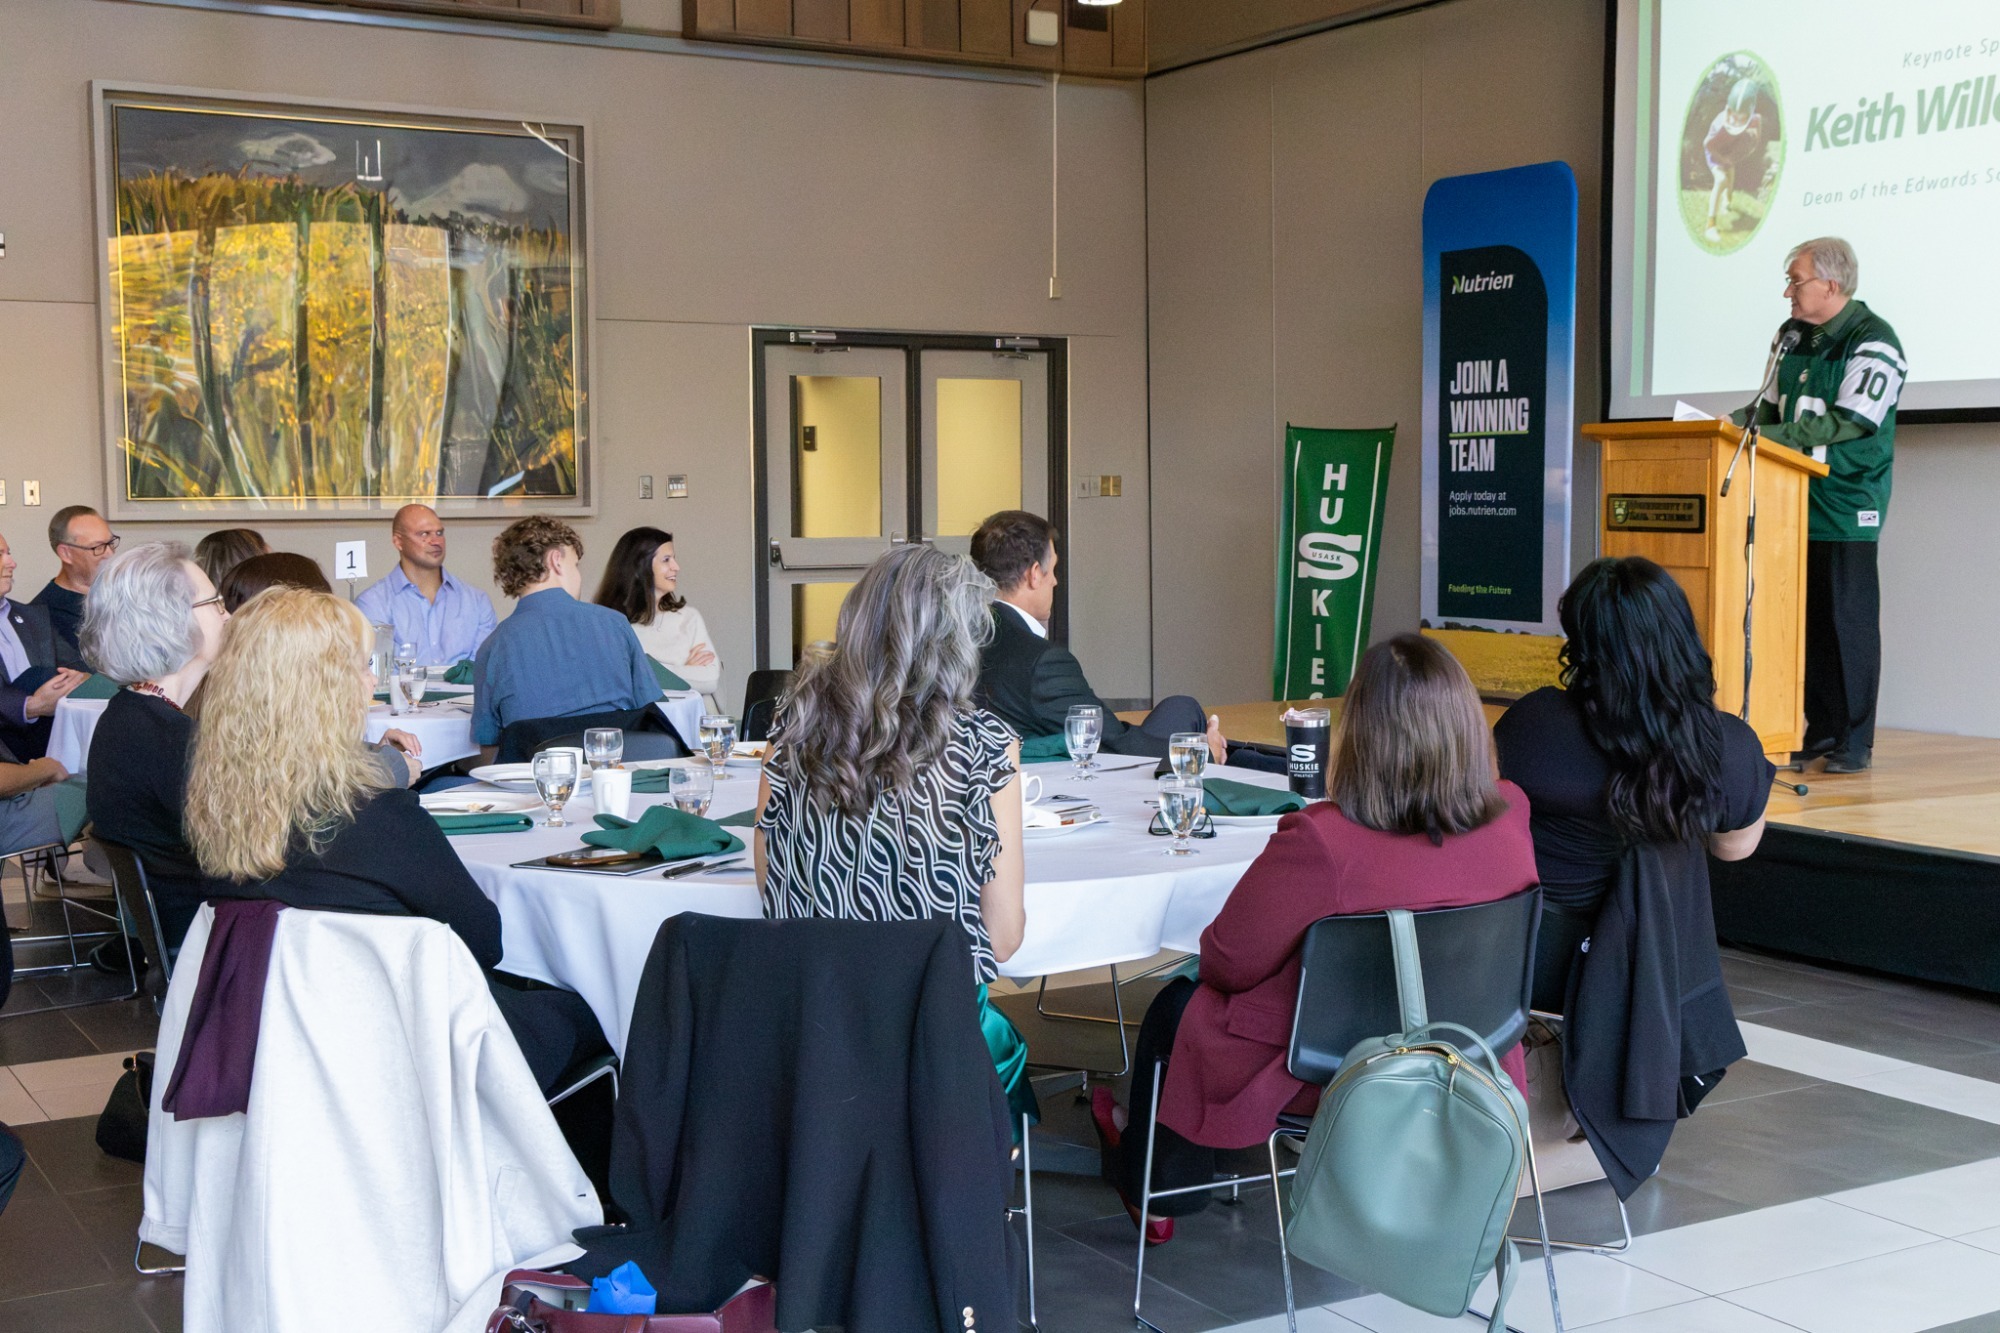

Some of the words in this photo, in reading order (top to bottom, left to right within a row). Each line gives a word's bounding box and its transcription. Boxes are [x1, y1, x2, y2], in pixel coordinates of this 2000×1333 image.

[1902, 43, 1972, 69] Keynote
[1979, 37, 2000, 57] Sp
[1804, 91, 1906, 152] Keith
[1803, 191, 1843, 207] Dean
[1849, 182, 1867, 201] of
[1872, 181, 1899, 198] the
[1904, 169, 1978, 194] Edwards
[1451, 270, 1514, 295] Nutrien
[1450, 360, 1493, 395] JOIN
[1496, 359, 1509, 393] A
[1854, 366, 1889, 402] 10
[1450, 397, 1530, 433] WINNING
[1449, 438, 1496, 473] TEAM
[1449, 490, 1473, 503] Apply
[1473, 490, 1497, 503] today
[1497, 491, 1507, 501] at
[1449, 504, 1517, 518] jobs.nutrien.com
[346, 550, 357, 570] 1
[1312, 551, 1341, 562] USASK
[1298, 463, 1362, 700] HUSKIE
[1448, 583, 1476, 596] Feeding
[1475, 584, 1488, 595] the
[1488, 585, 1512, 596] Future
[1289, 762, 1320, 771] HUSKIE
[1290, 743, 1317, 763] S
